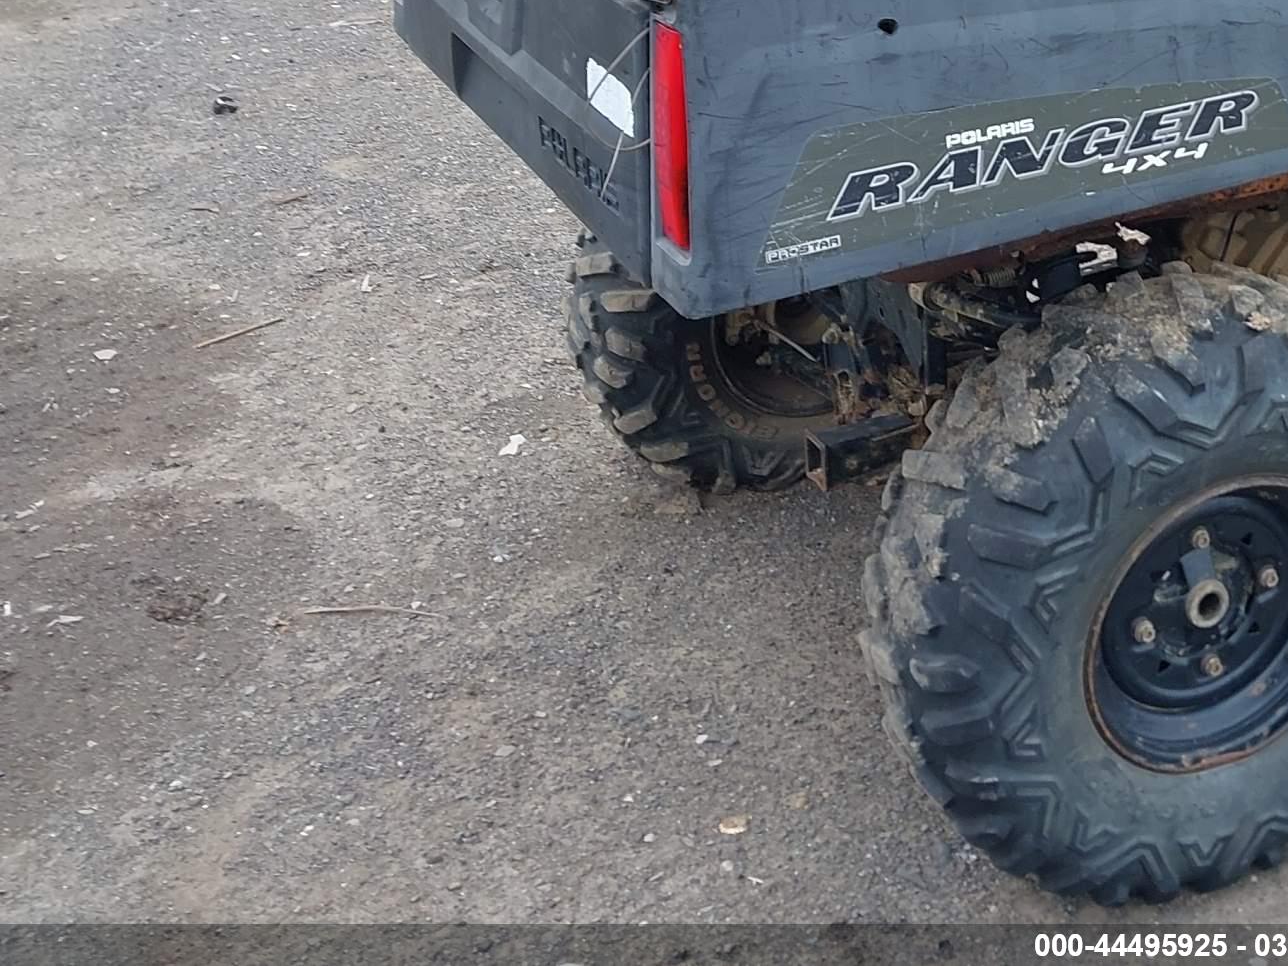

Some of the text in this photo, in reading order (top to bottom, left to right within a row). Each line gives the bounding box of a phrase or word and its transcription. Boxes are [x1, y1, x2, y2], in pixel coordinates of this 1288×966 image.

[945, 118, 1035, 149] POLARIS
[825, 90, 1260, 222] RANGER
[767, 236, 840, 263] PROSTAR
